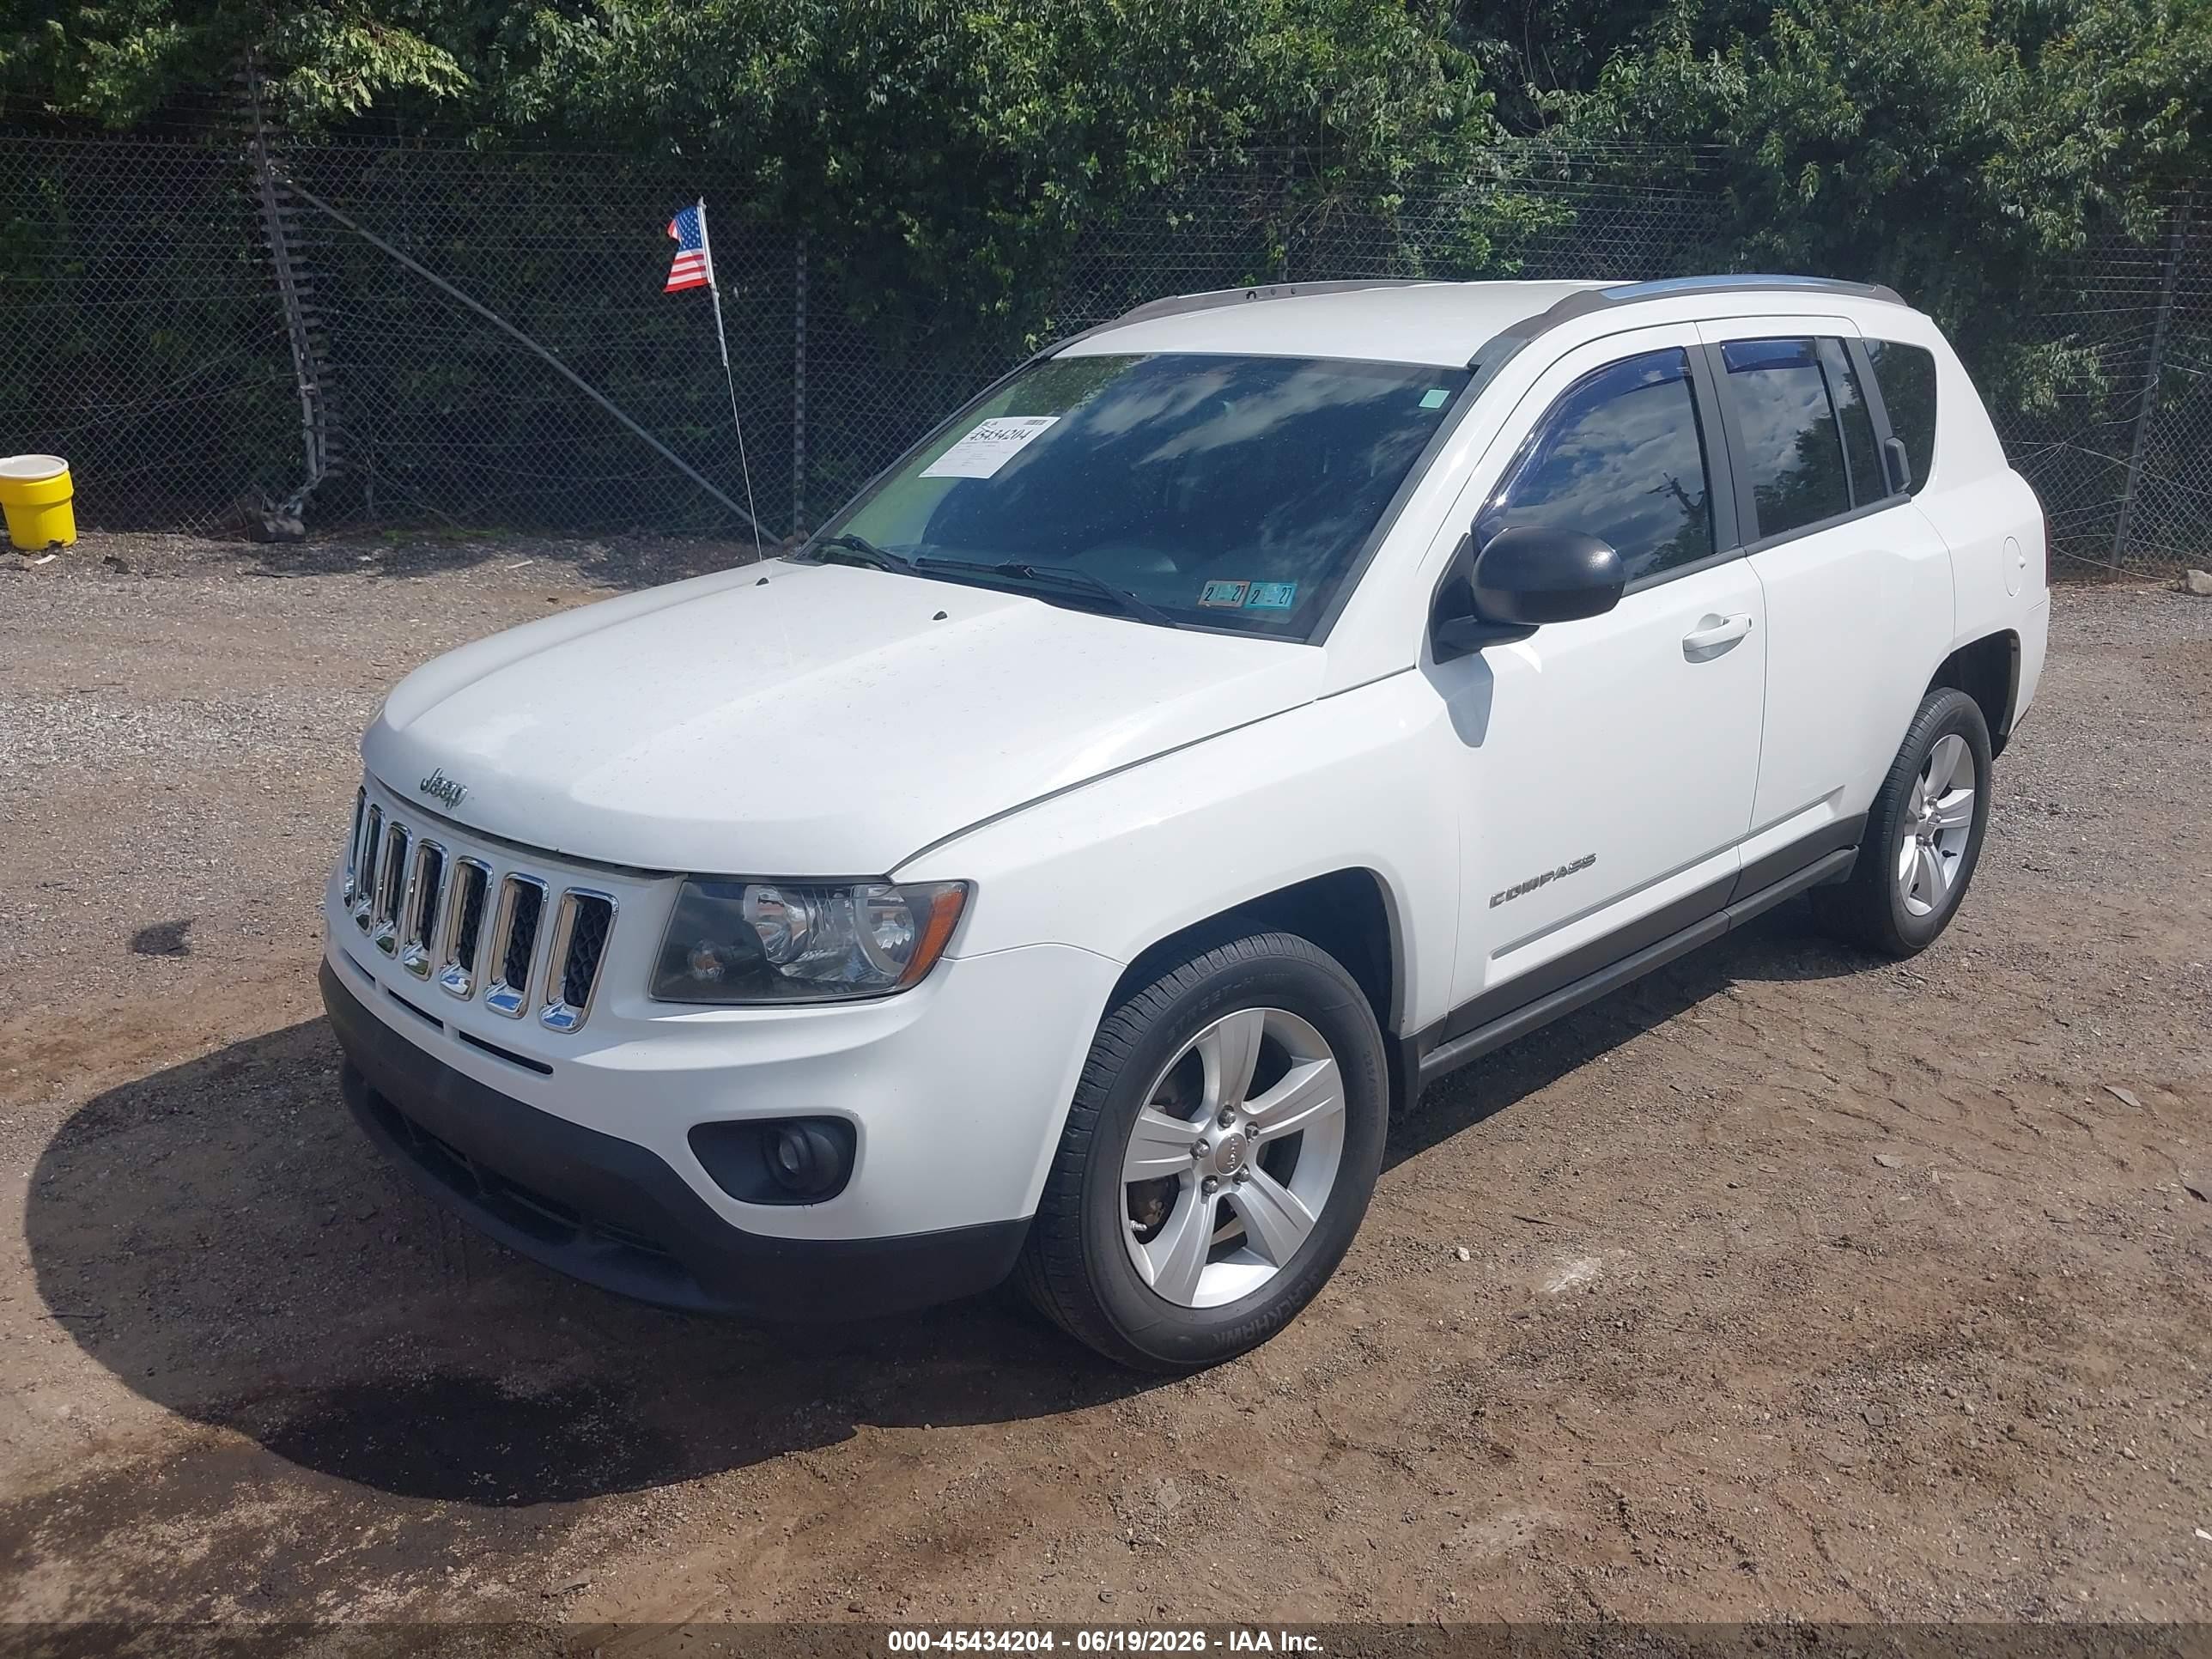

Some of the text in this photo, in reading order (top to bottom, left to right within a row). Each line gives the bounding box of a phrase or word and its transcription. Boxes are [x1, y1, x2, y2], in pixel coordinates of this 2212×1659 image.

[969, 428, 1033, 441] 45434204
[1205, 585, 1245, 603] 2 27
[1250, 586, 1292, 605] 2 27
[420, 768, 468, 810] Jeep
[1488, 853, 1596, 909] COMPASS
